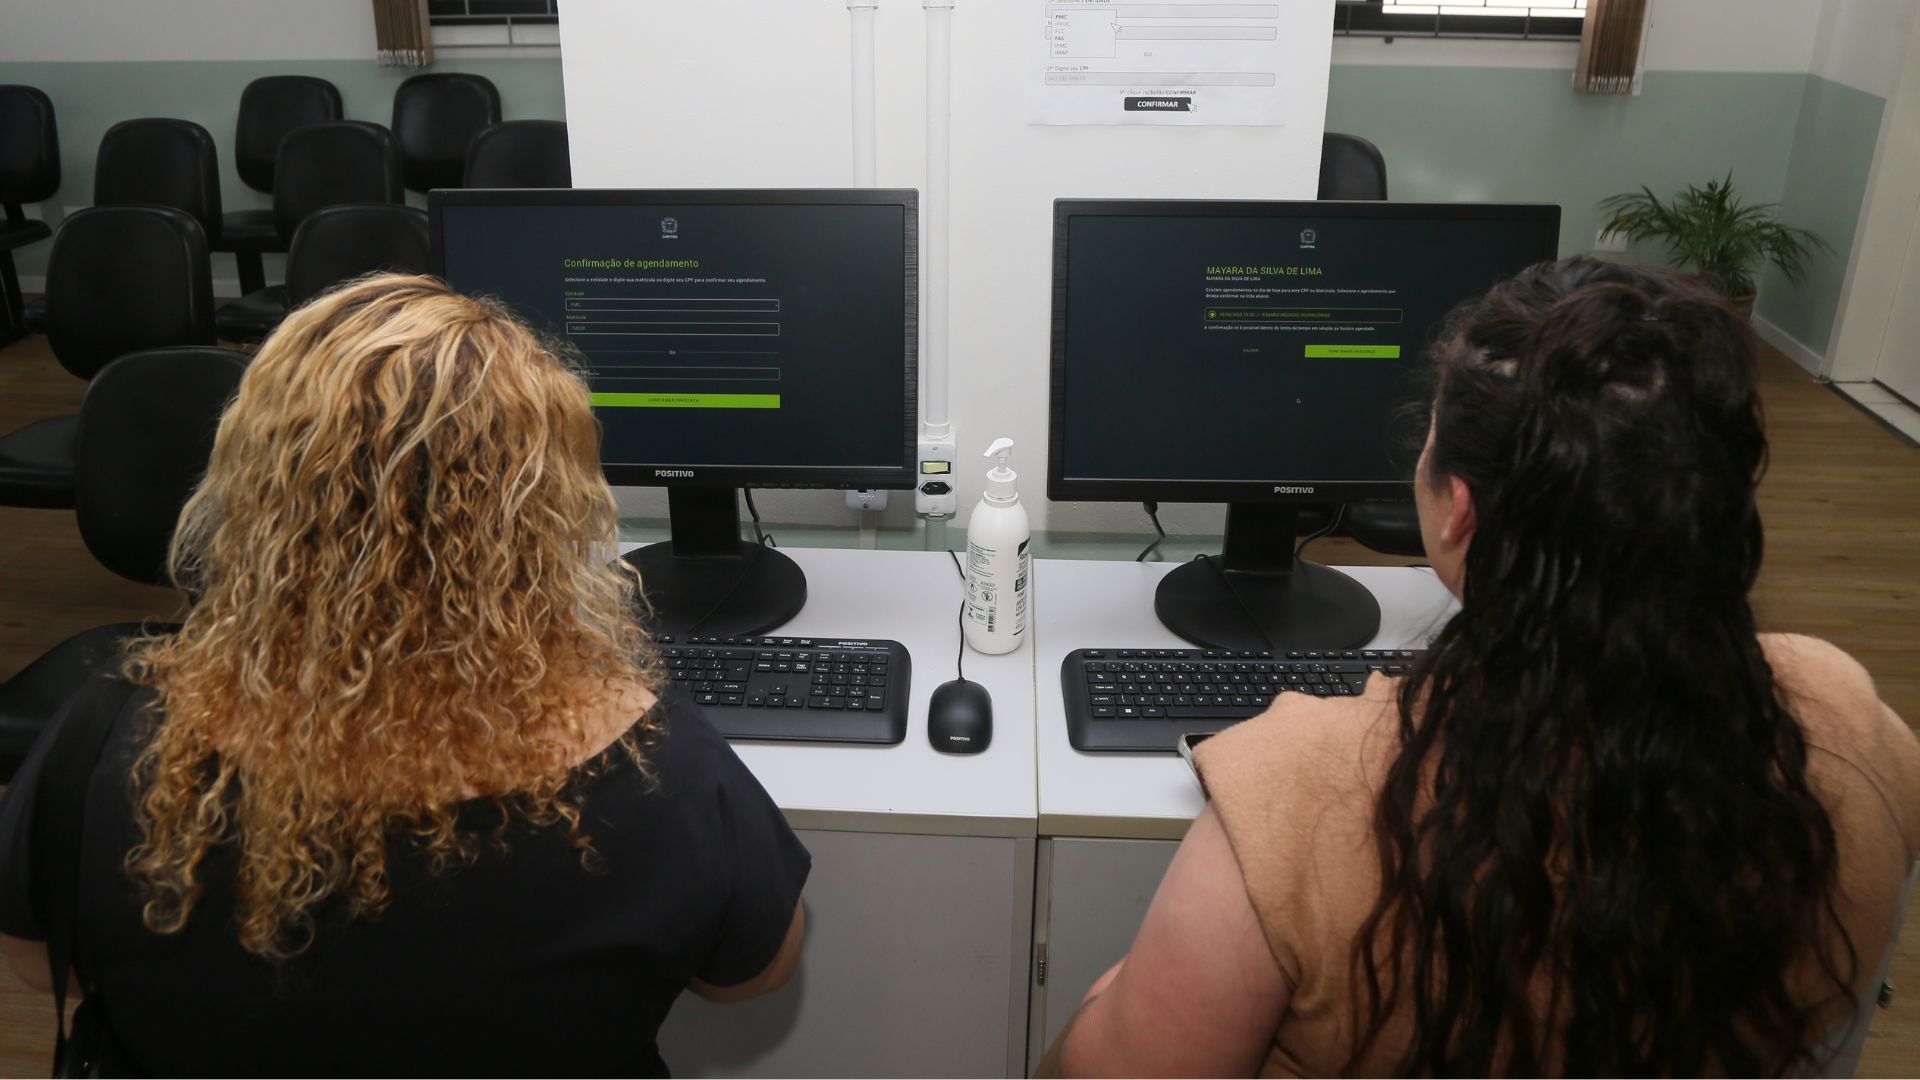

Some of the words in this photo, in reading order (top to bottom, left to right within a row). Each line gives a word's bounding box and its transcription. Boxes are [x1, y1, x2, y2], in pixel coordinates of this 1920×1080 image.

[564, 258, 622, 270] Confirmação
[624, 258, 635, 268] de
[637, 258, 699, 270] agendamento
[1207, 266, 1244, 275] MAYARA
[1246, 266, 1258, 275] DA
[1260, 266, 1284, 275] SILVA
[1286, 267, 1298, 275] DE
[1300, 267, 1322, 275] LIMA
[655, 469, 695, 478] POSITIVO
[1273, 486, 1314, 494] POSITIVO
